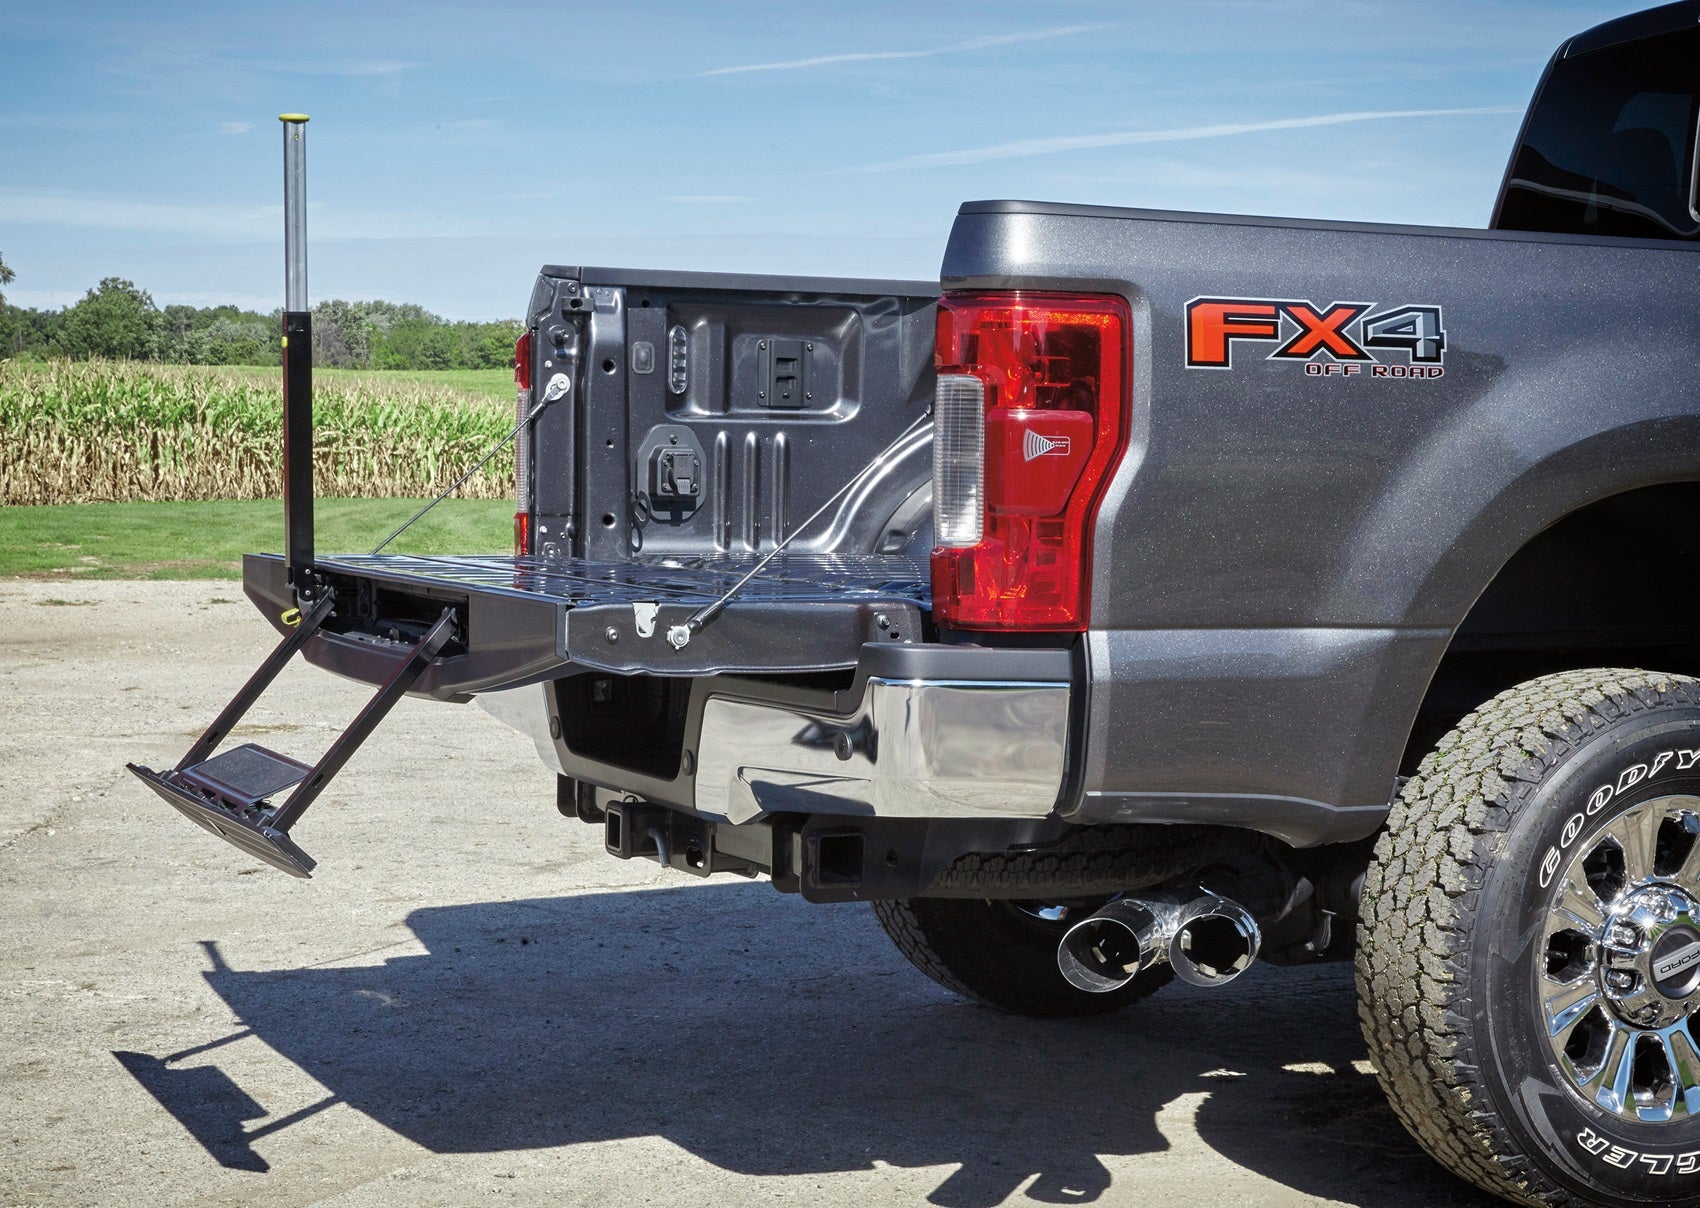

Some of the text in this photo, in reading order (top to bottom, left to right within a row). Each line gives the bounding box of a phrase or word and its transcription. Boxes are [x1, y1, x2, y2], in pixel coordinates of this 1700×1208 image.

[1184, 295, 1447, 370] FX4
[1305, 363, 1444, 379] OFF ROAD
[1660, 950, 1700, 974] FORD
